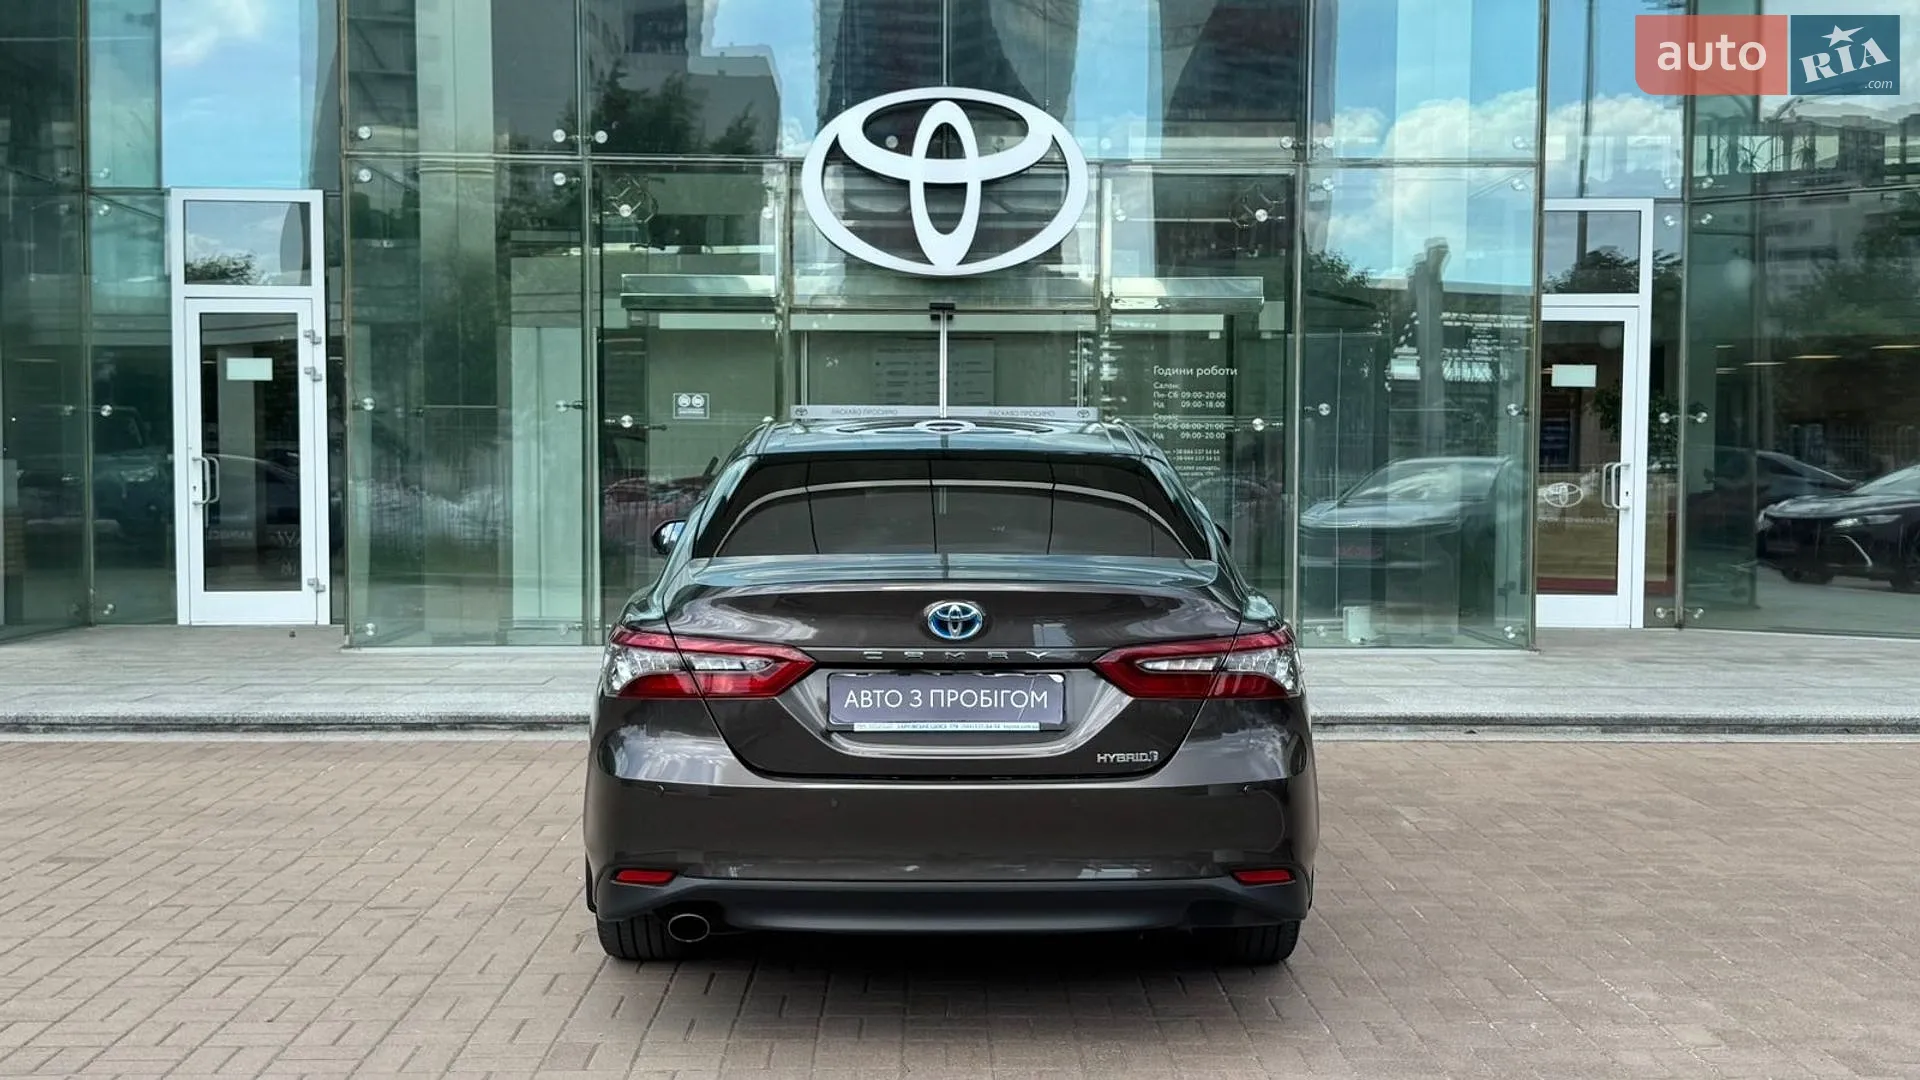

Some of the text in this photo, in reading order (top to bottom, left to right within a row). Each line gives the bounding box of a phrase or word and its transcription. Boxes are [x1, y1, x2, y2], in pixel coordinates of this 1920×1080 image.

[1153, 365, 1238, 378] Години роботи
[844, 689, 903, 709] АВТО
[929, 689, 1048, 709] ПРОБІГОМ
[1097, 752, 1149, 763] HYBRID
